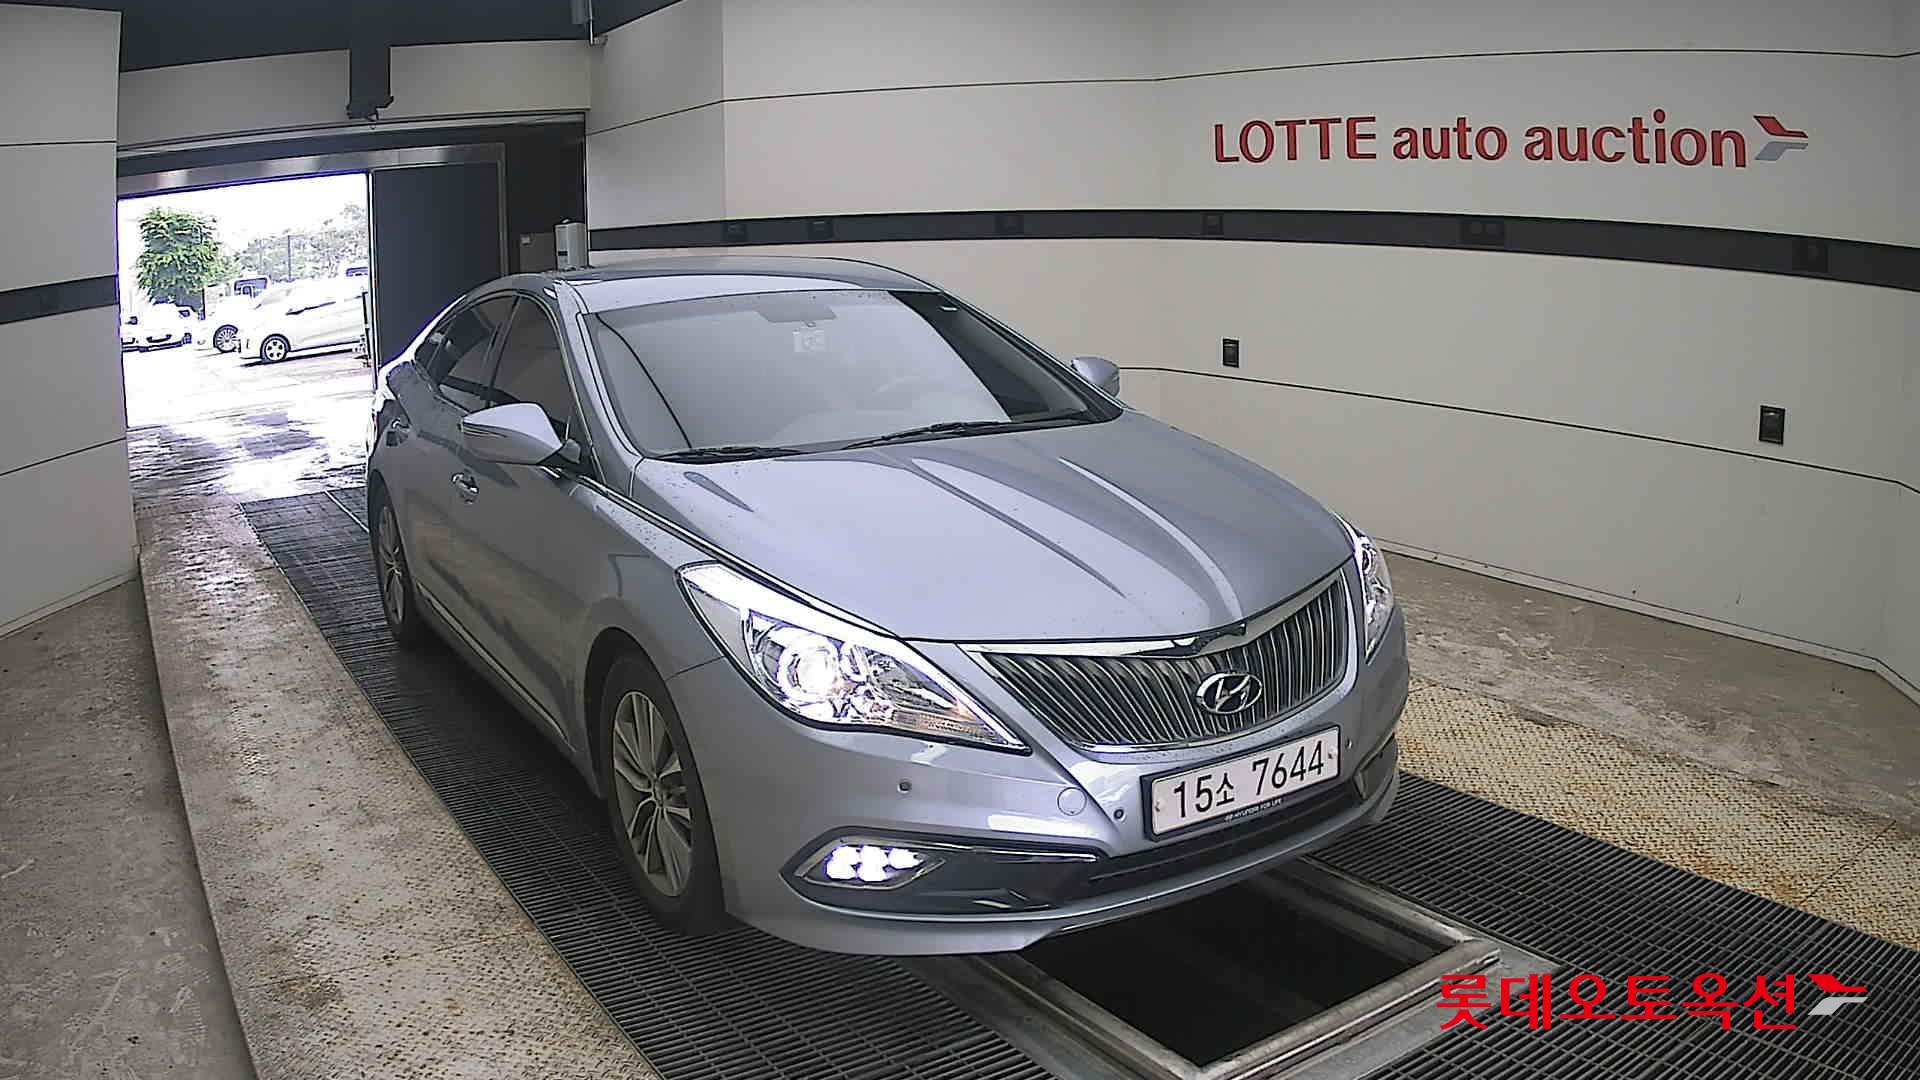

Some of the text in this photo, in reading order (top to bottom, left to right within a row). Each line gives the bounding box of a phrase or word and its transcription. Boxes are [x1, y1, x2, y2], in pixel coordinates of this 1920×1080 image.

[1214, 109, 1746, 168] LOTTE auto auction
[1174, 740, 1324, 818] 15소 7644
